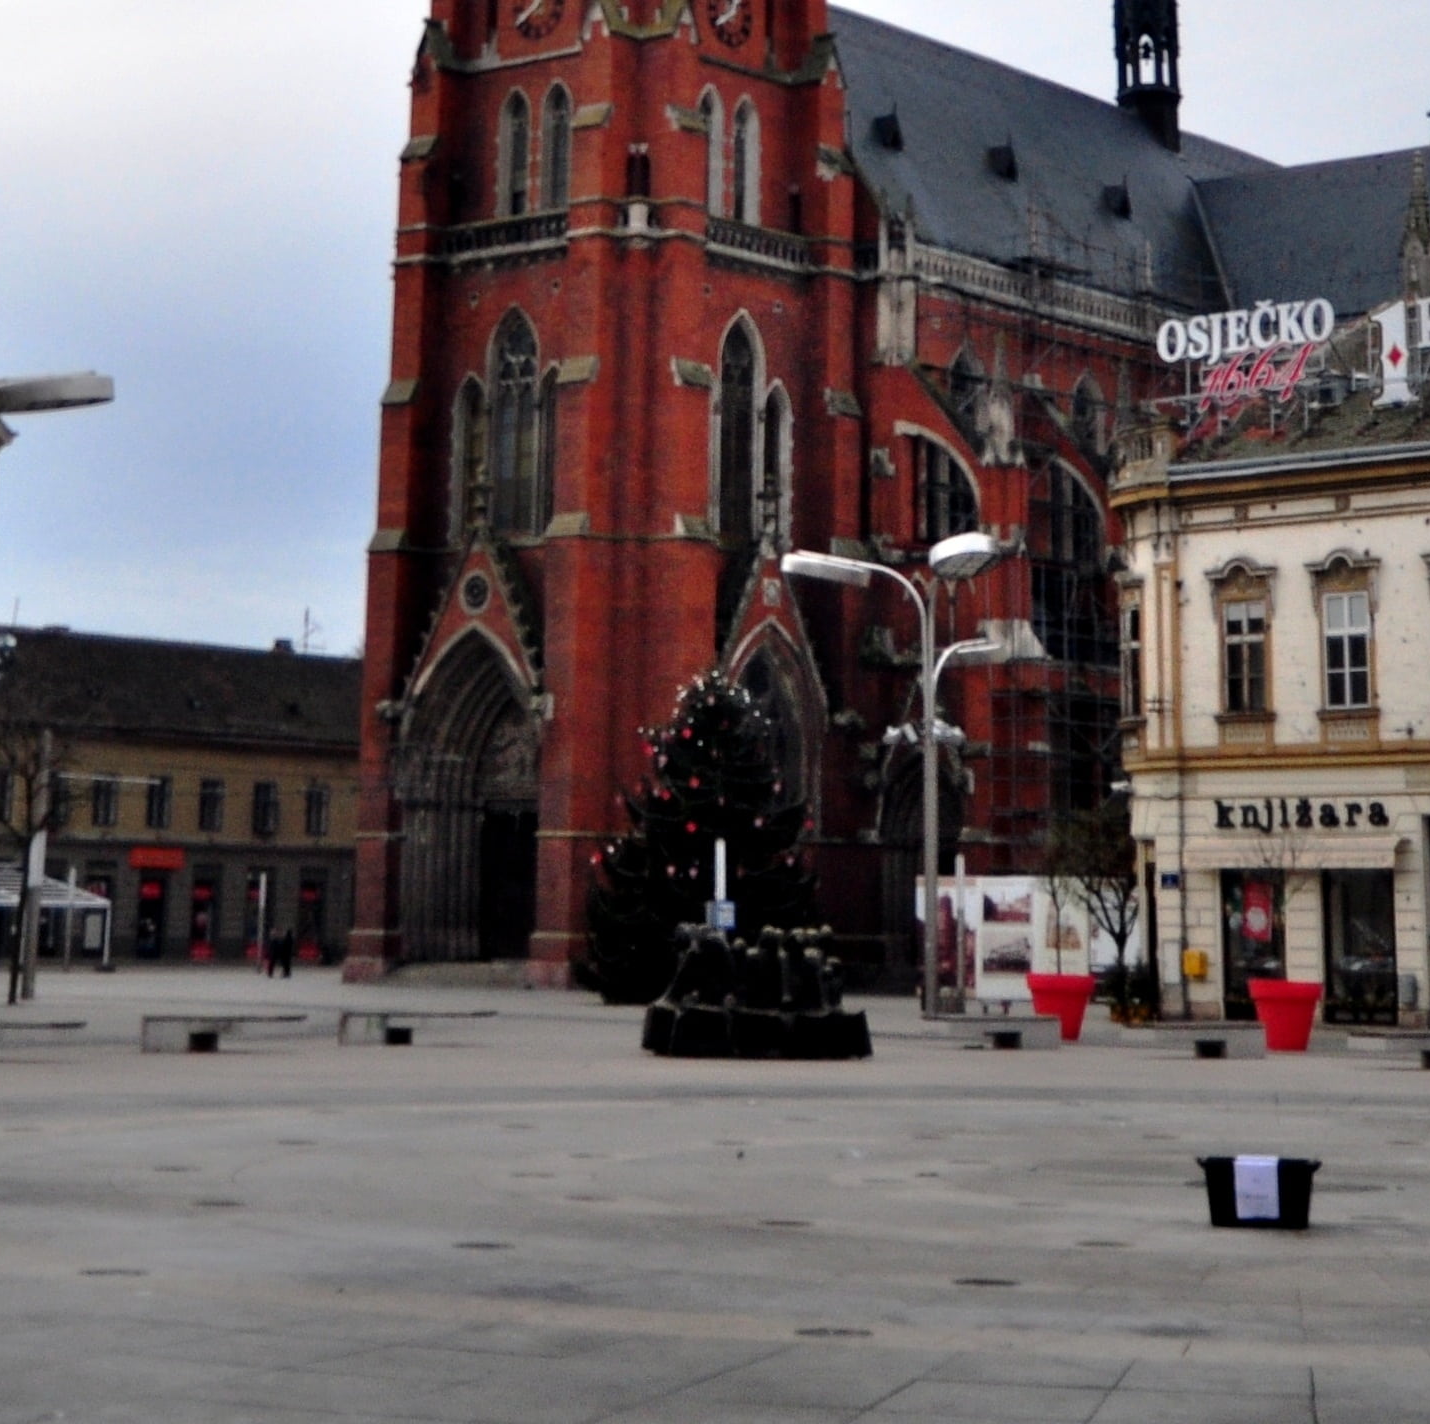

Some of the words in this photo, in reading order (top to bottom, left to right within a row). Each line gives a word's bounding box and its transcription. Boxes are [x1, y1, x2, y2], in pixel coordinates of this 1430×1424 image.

[1156, 298, 1335, 364] OSJEČKO
[1197, 341, 1317, 413] 1664
[1214, 798, 1390, 834] knjižara
